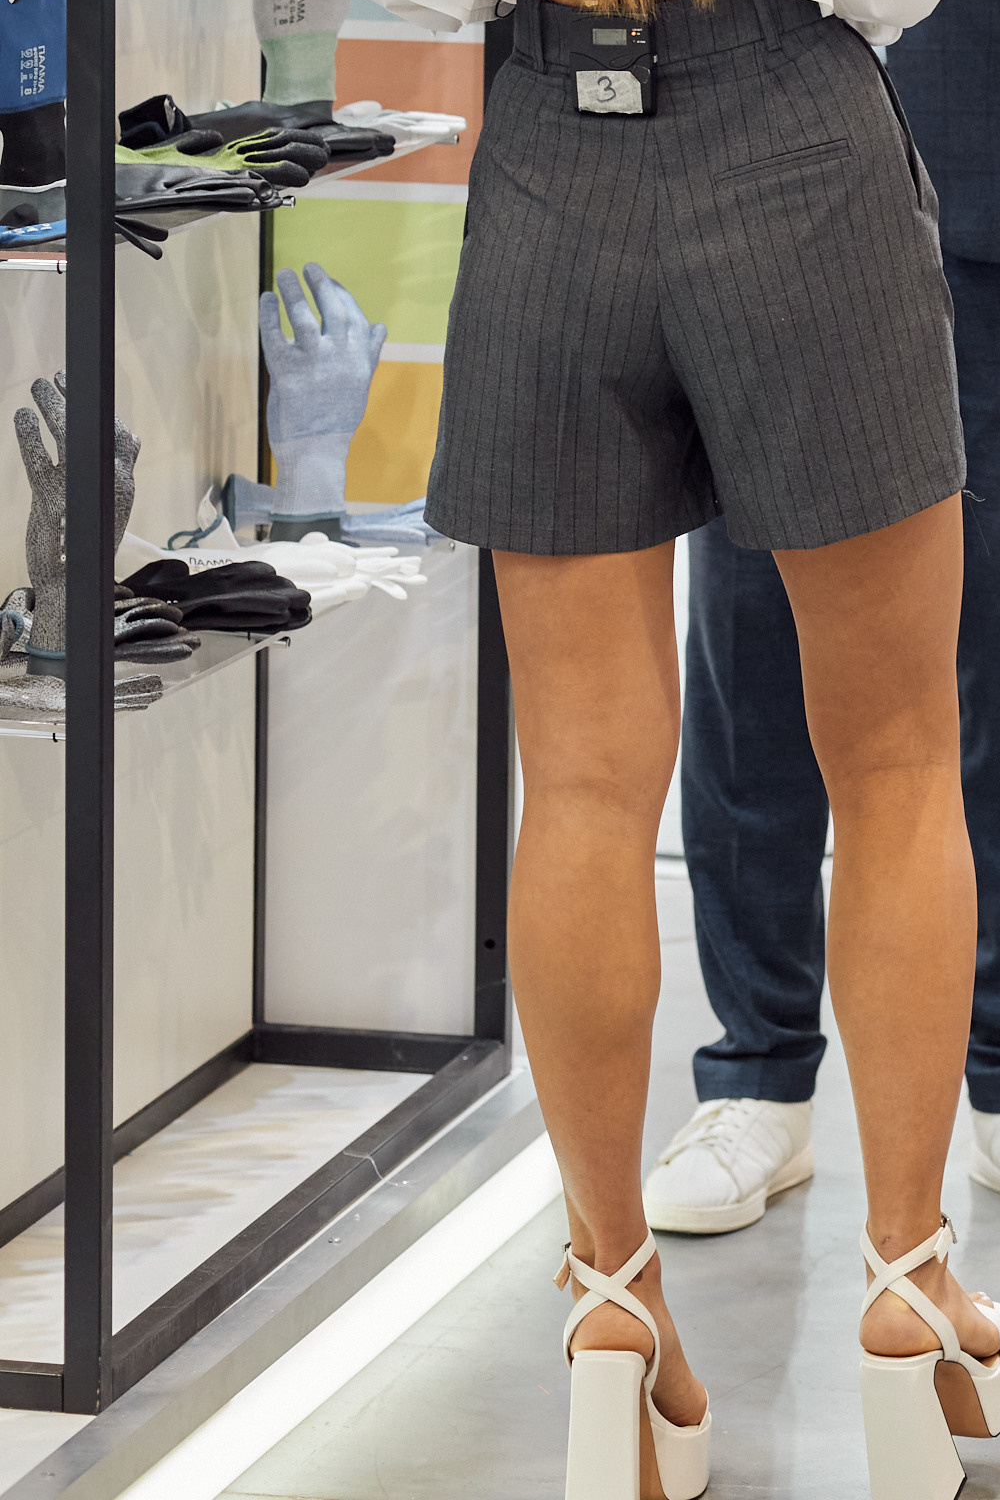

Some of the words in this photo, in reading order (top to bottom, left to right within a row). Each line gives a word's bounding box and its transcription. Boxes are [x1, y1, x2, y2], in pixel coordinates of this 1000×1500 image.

[38, 45, 46, 94] ПАЛМА
[24, 87, 33, 96] 8
[597, 75, 617, 104] 3
